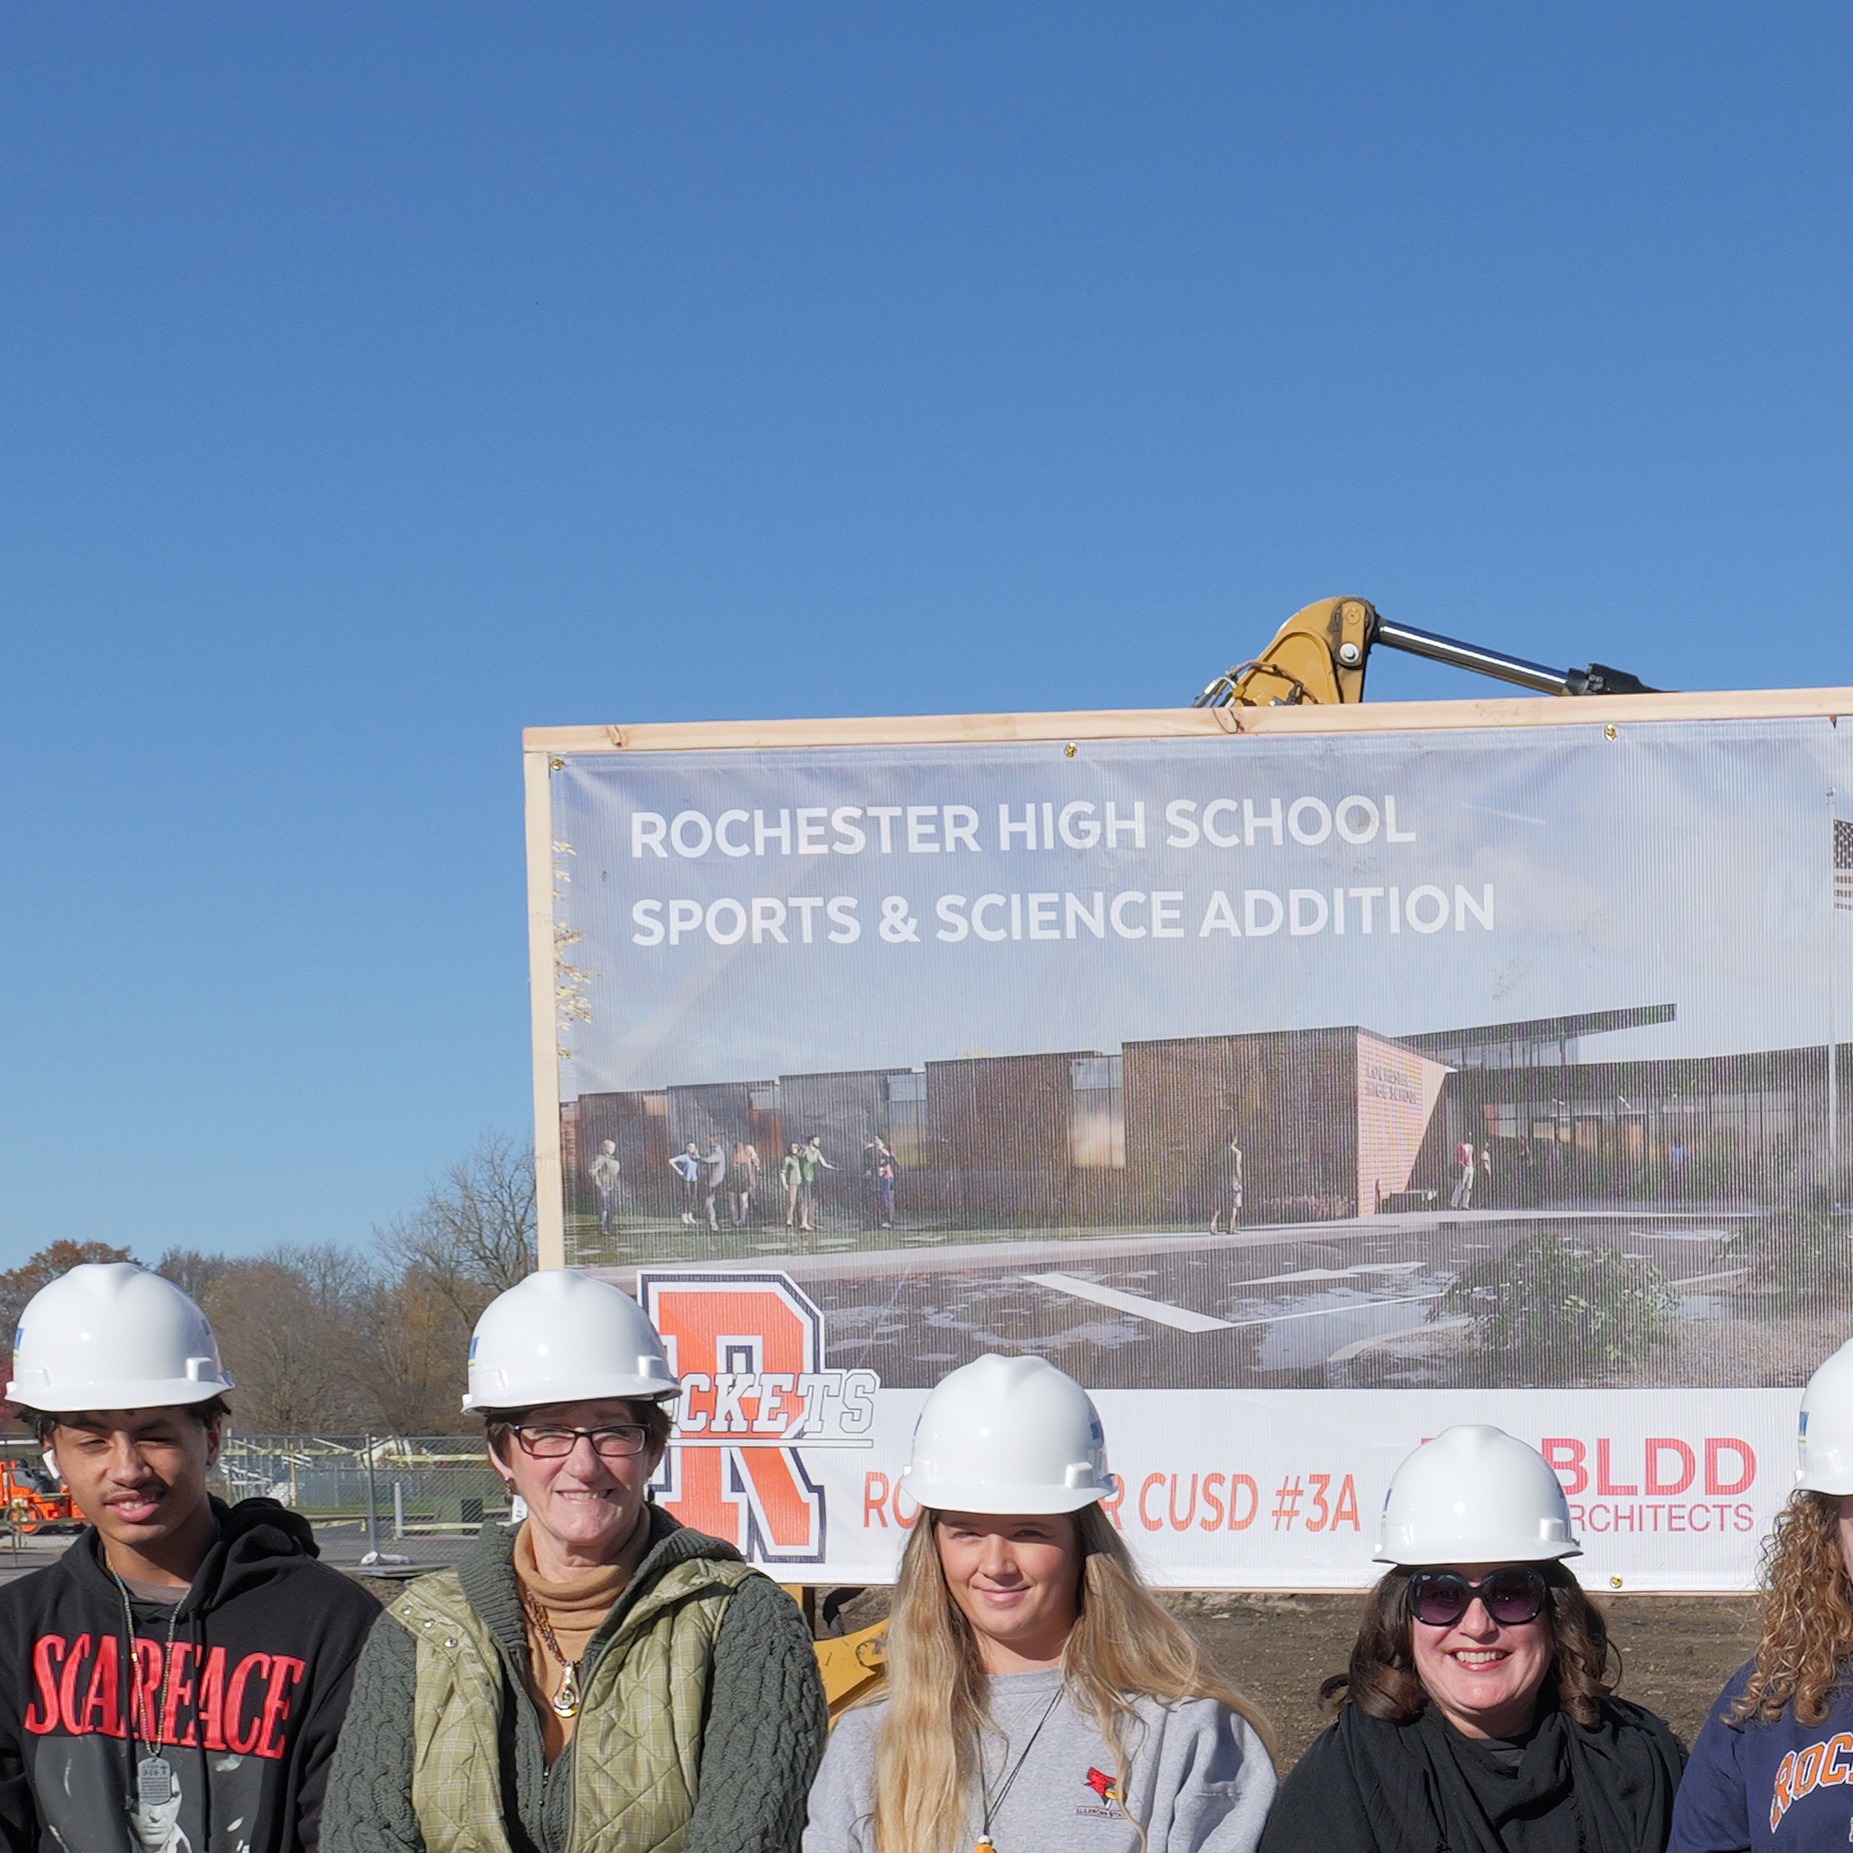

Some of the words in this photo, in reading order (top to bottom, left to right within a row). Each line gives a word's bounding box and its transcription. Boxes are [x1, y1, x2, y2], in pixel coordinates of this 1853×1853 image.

[631, 805, 982, 859] ROCHESTER
[999, 801, 1146, 851] HIGH
[1165, 795, 1416, 849] SCHOOL
[631, 896, 862, 946] SPORTS
[878, 895, 922, 944] &
[936, 890, 1185, 943] SCIENCE
[1198, 883, 1495, 938] ADDITION
[670, 1371, 879, 1434] CKETS
[1541, 1437, 1757, 1496] BLDD
[1138, 1472, 1260, 1532] CUSD
[1271, 1473, 1361, 1532] #3A
[1569, 1503, 1754, 1532] RCHITECTS
[24, 1633, 306, 1760] SCARFACE
